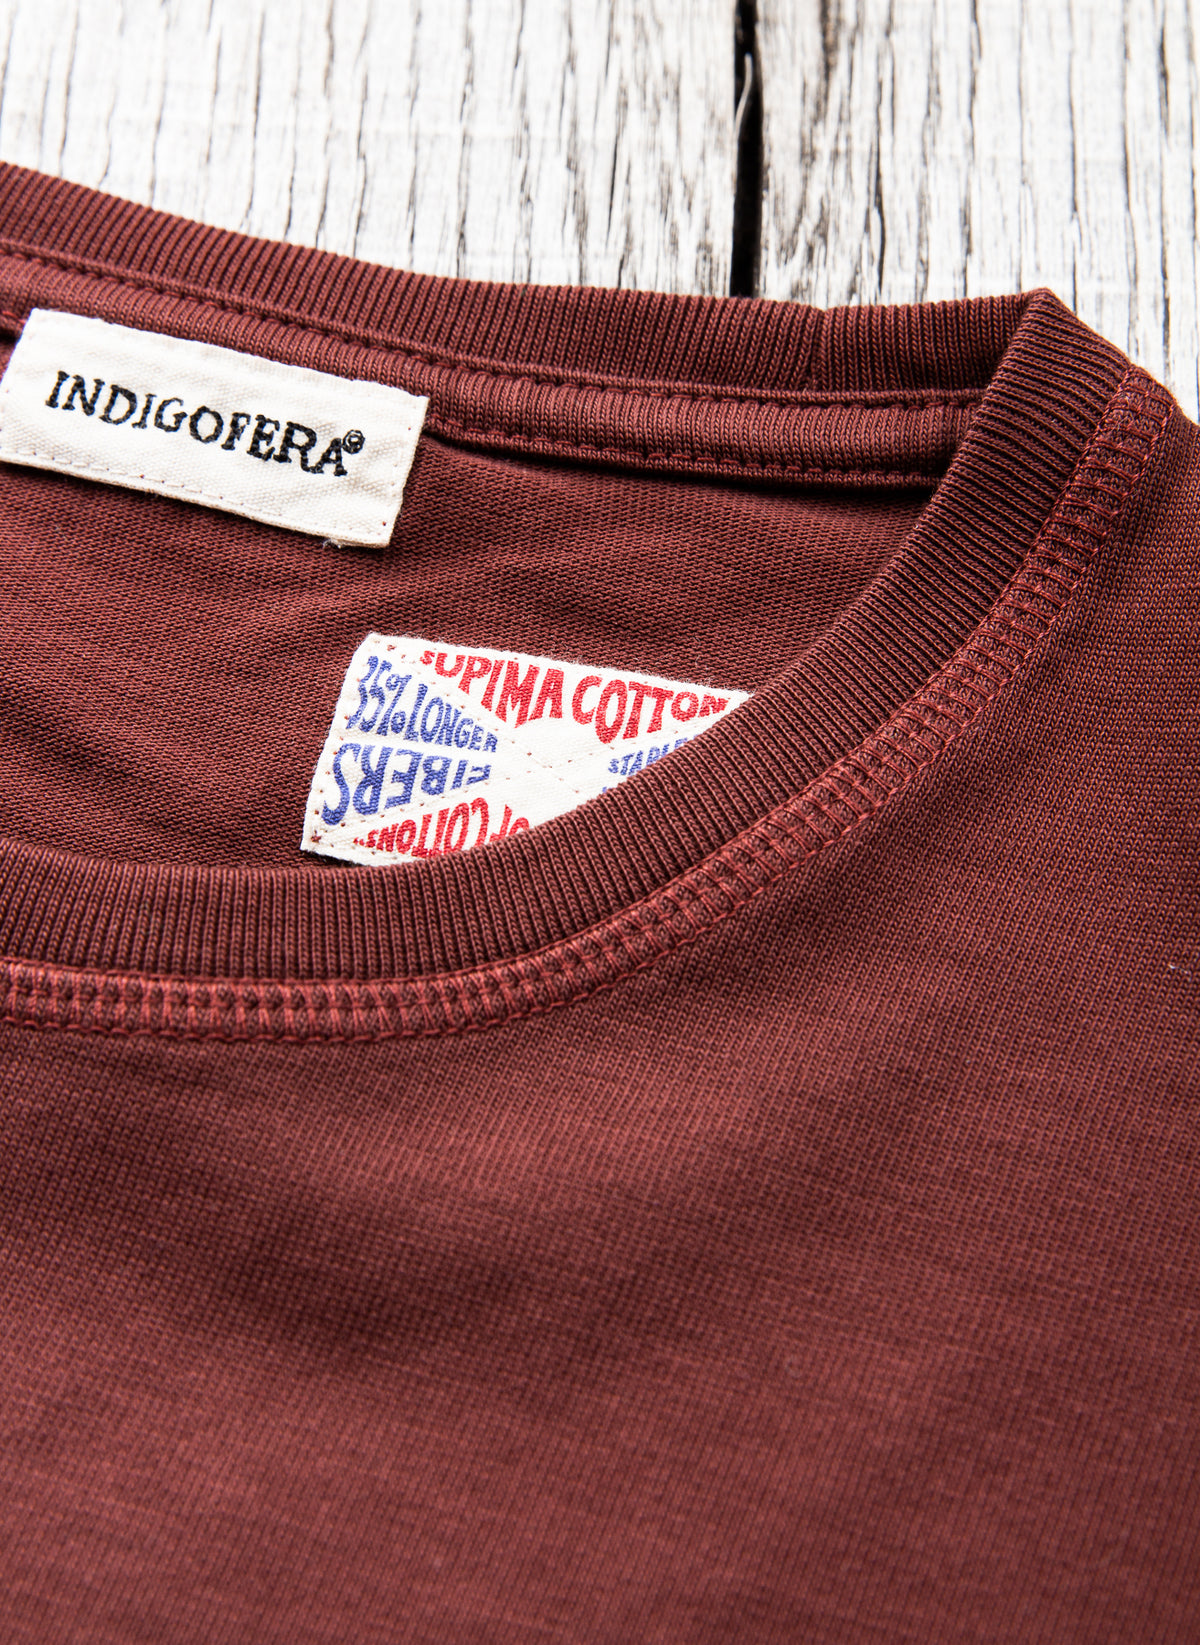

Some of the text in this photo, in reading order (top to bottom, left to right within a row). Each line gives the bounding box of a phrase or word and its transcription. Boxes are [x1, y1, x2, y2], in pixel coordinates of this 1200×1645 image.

[346, 655, 498, 752] 35% LONGER
[420, 650, 729, 744] SUPIMA COTTON
[321, 743, 492, 825] FIBERS
